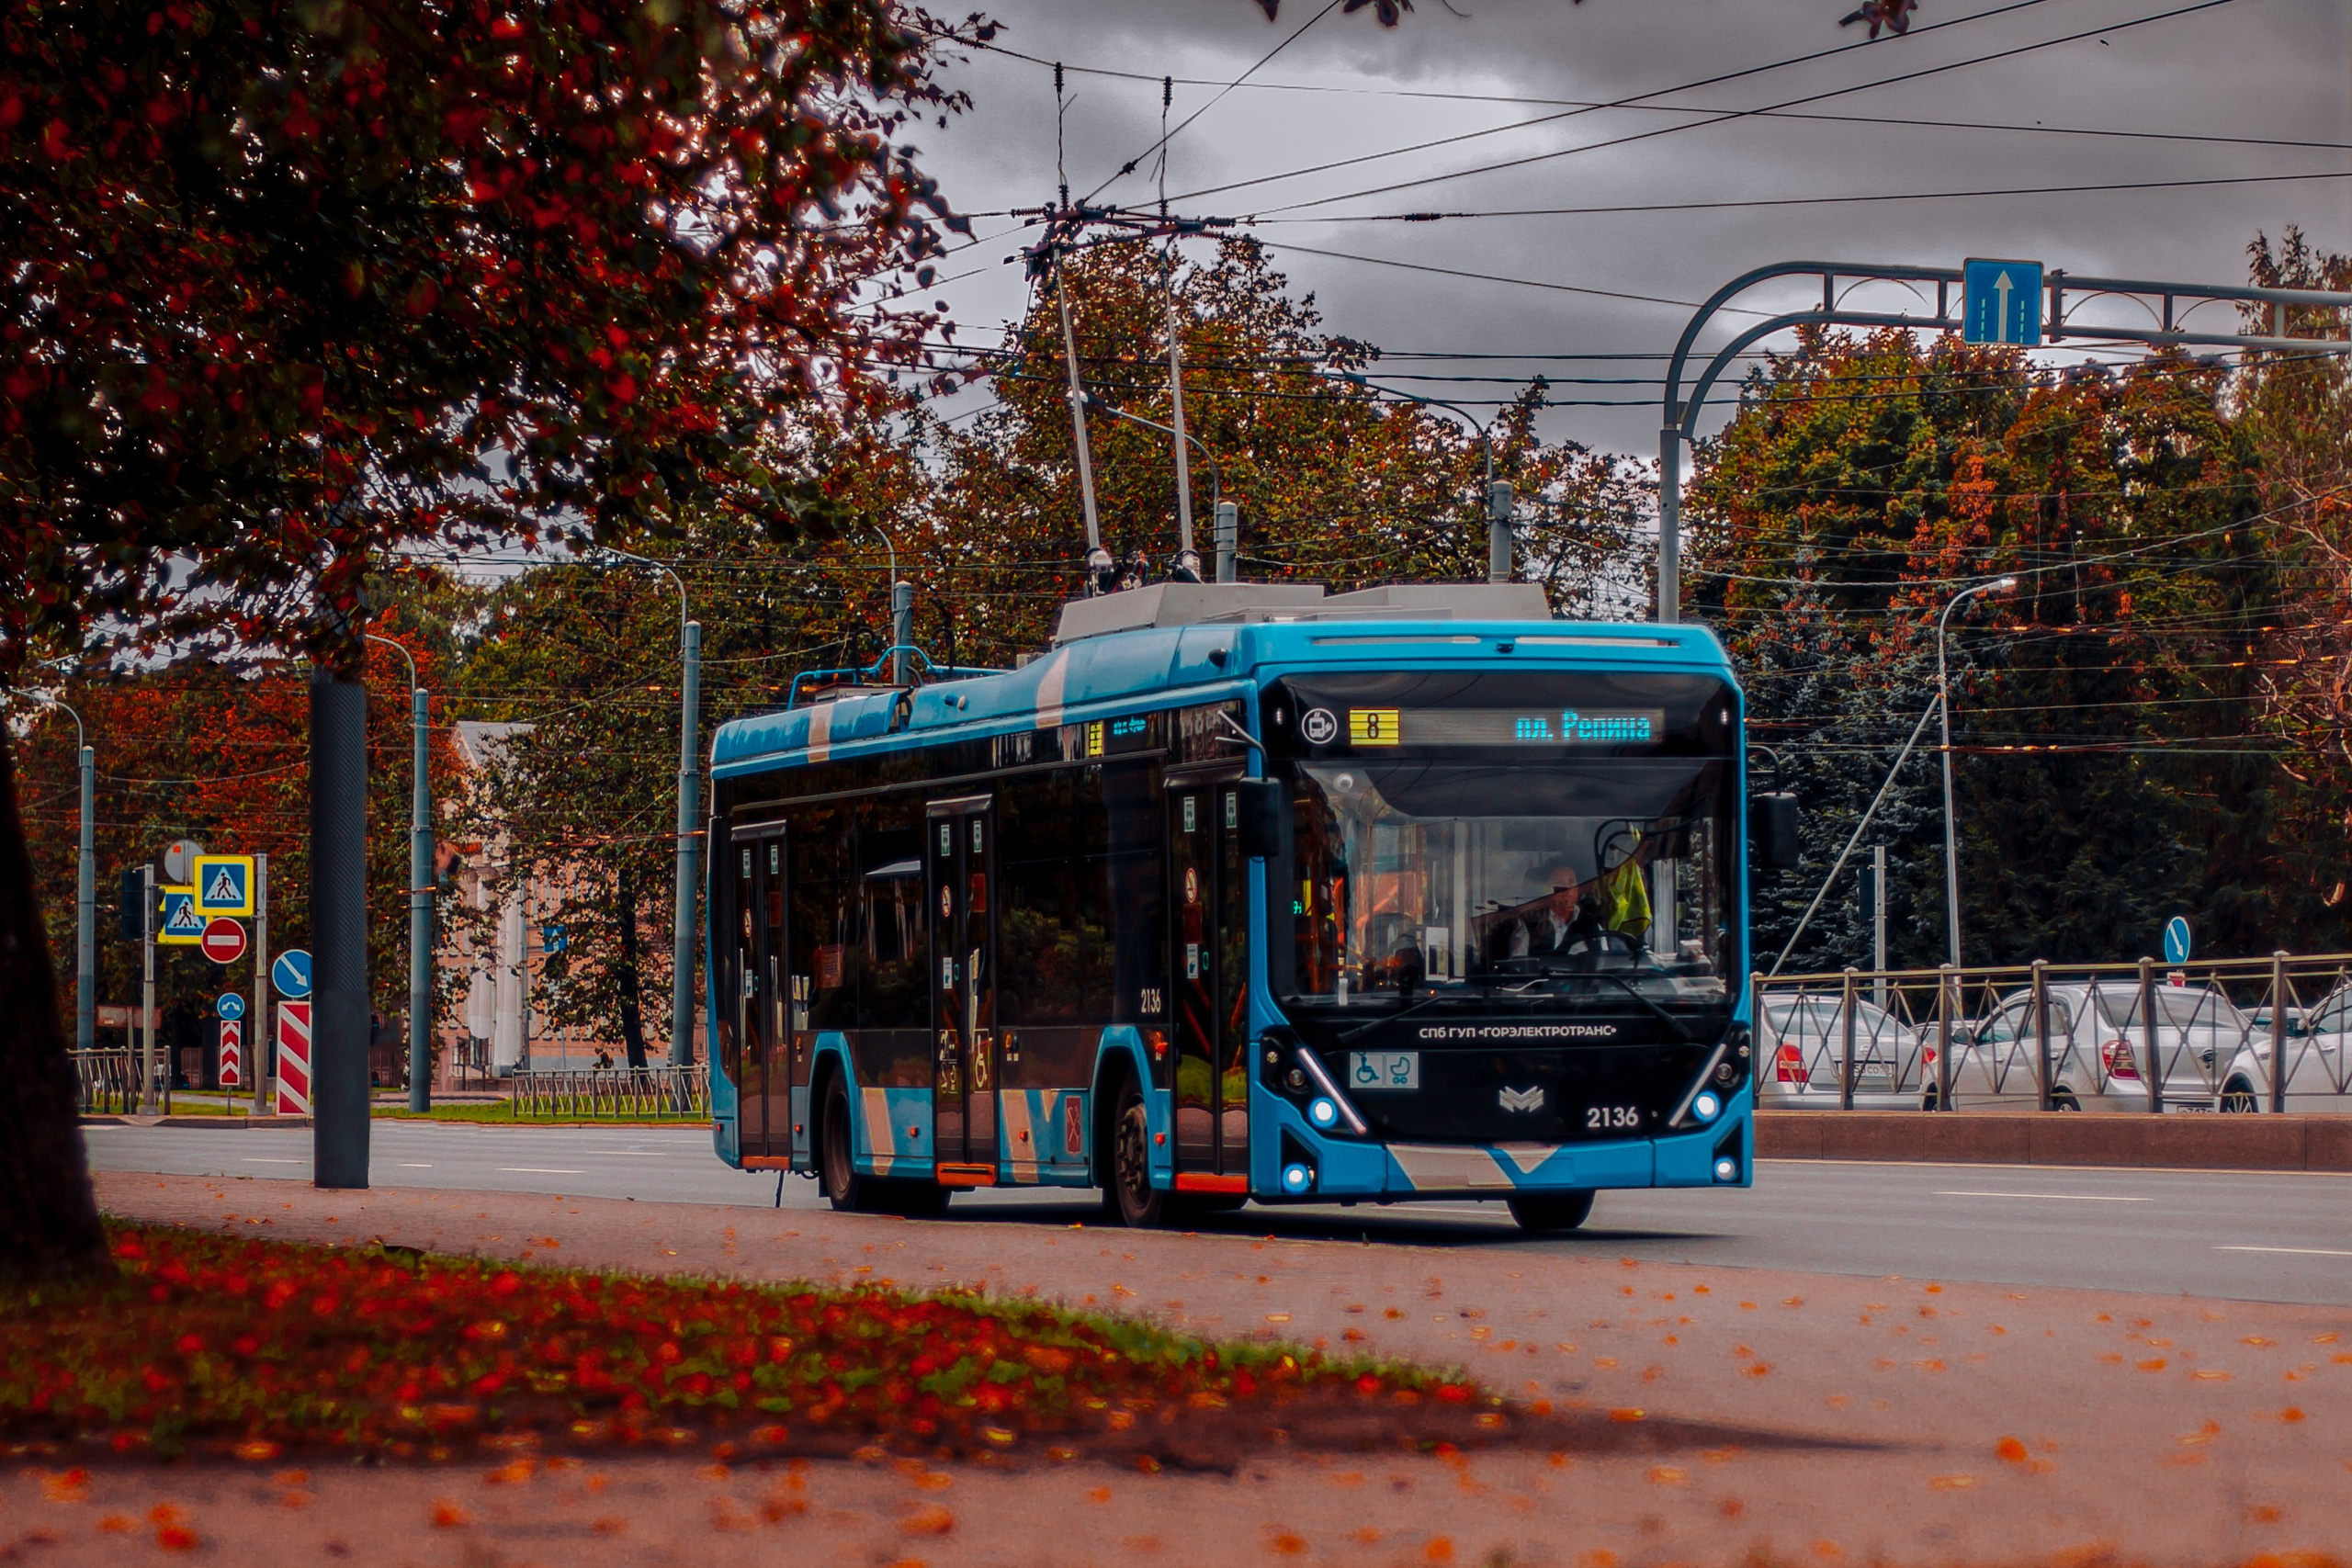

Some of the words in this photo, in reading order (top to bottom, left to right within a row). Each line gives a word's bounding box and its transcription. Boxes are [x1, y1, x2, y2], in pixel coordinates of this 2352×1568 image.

[1367, 713, 1379, 739] 8
[1517, 717, 1554, 740] пл.
[1564, 710, 1650, 740] Репина
[1141, 988, 1161, 1013] 2136
[1419, 1027, 1446, 1039] СПб
[1449, 1027, 1476, 1038] ГУП
[1478, 1025, 1617, 1038] «ГОРЭЛЕКТРОТРАНС»
[1587, 1106, 1639, 1127] 2136
